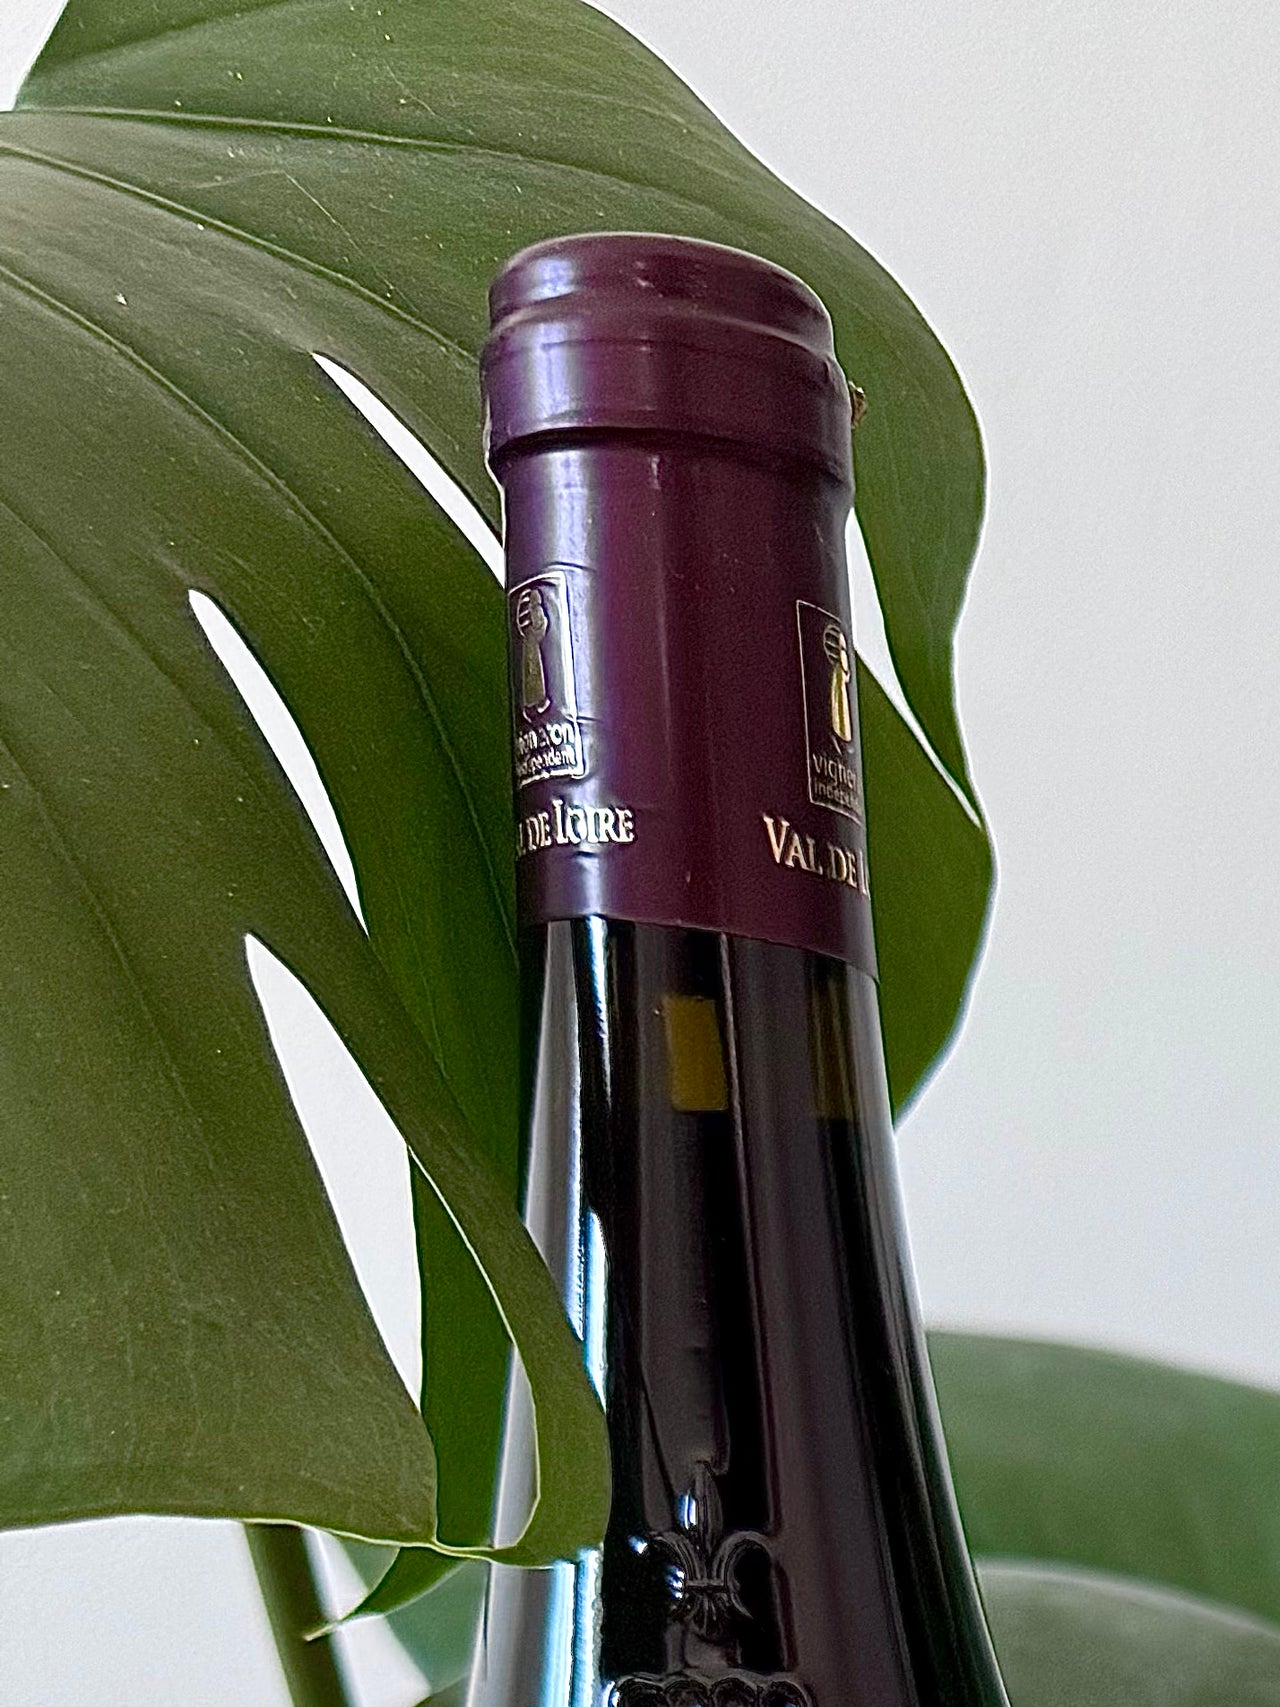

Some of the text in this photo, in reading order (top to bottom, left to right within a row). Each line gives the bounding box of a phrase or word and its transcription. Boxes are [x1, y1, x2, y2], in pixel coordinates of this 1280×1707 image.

[526, 812, 551, 850] DE
[552, 799, 634, 844] LOIRE
[762, 813, 823, 875] VAL
[827, 842, 858, 888] DE
